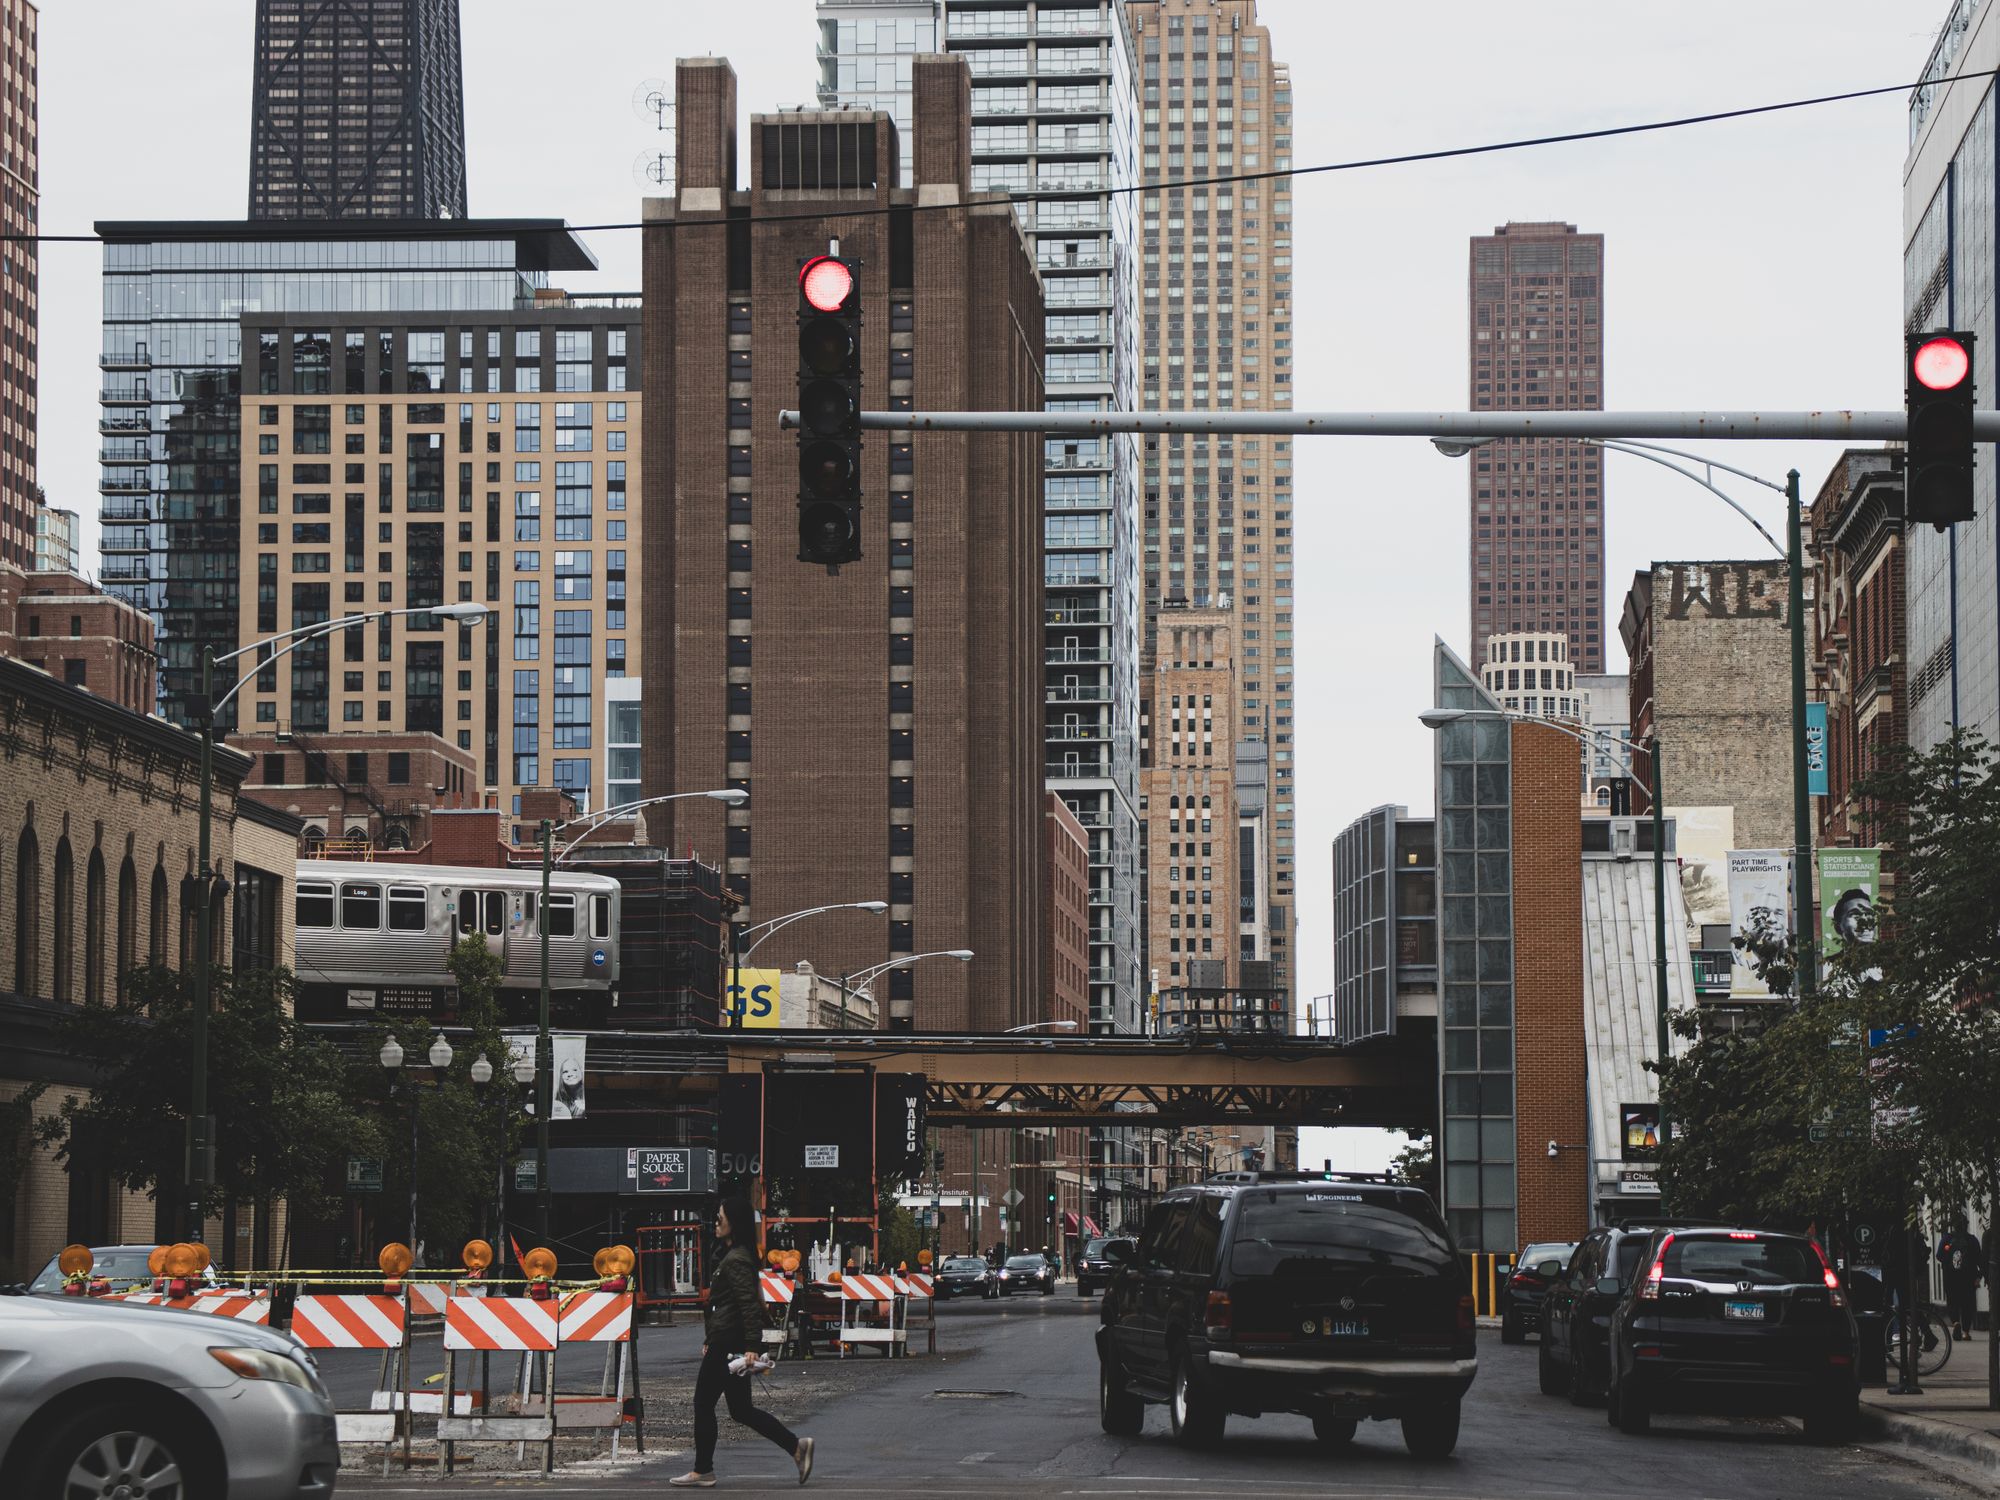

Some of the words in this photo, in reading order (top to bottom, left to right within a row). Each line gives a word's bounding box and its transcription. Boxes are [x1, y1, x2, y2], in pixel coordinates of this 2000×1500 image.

[1809, 727, 1824, 772] DANCE
[646, 1153, 680, 1163] PAPER
[721, 1152, 760, 1174] 506
[642, 1163, 684, 1173] SOURCE
[1633, 1173, 1653, 1181] Chic
[1861, 1228, 1870, 1242] P
[1334, 1321, 1356, 1335] 1167
